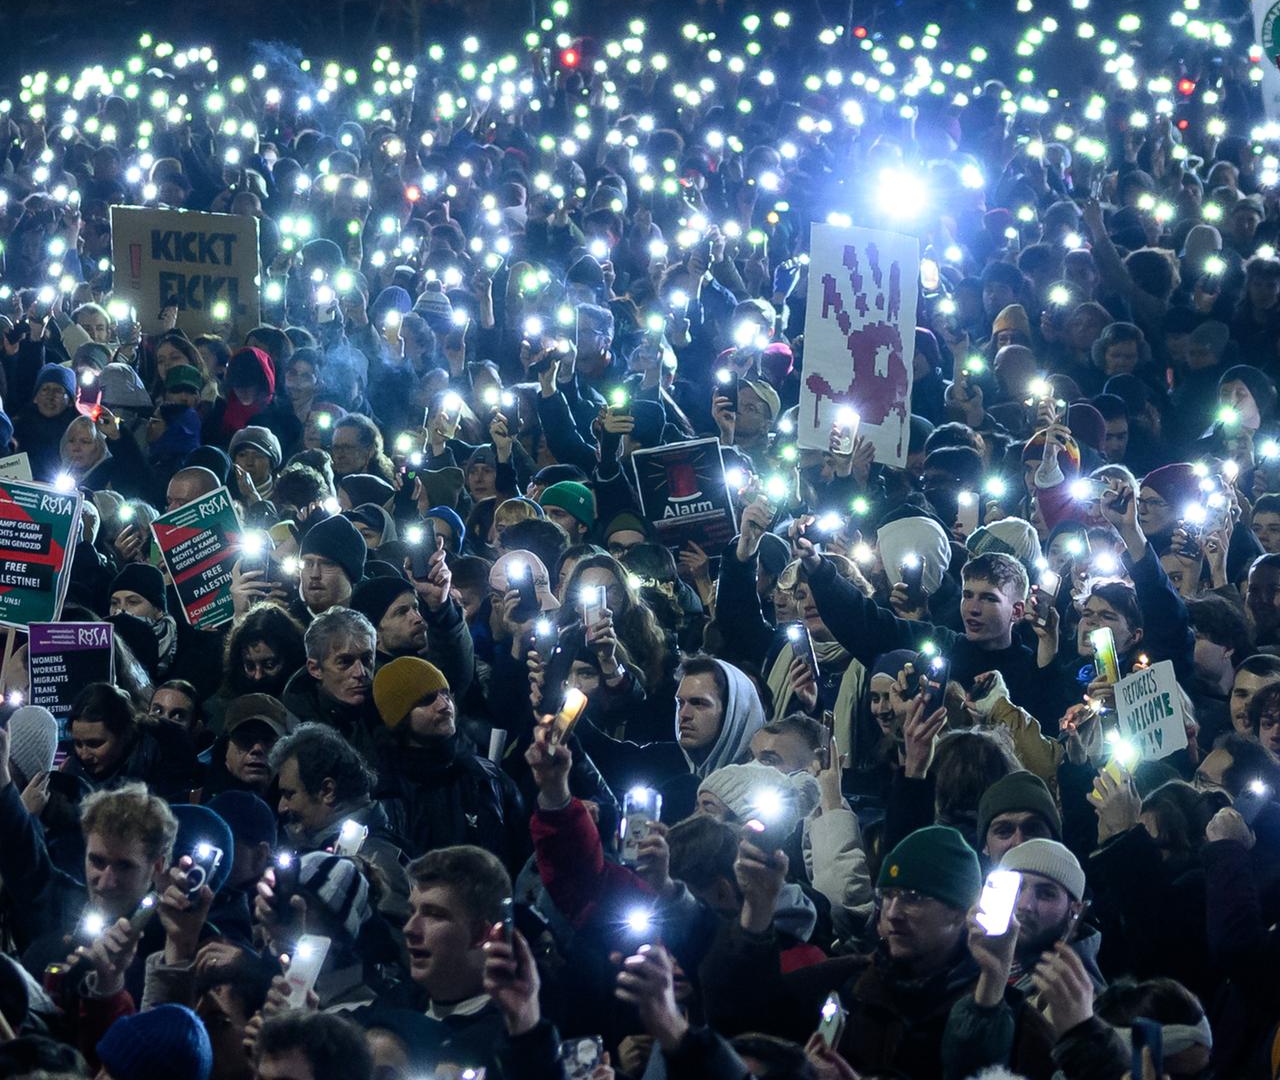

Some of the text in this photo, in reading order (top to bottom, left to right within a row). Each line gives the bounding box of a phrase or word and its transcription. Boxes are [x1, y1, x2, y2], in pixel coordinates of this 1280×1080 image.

[150, 229, 238, 265] KICKT
[663, 500, 713, 519] Alarm
[18, 522, 40, 531] GEGEN
[20, 531, 43, 541] KAMPF
[11, 540, 41, 550] GENOZID
[172, 529, 212, 554] KAMPF GEGEN
[171, 550, 194, 564] RECHTS
[198, 535, 218, 549] KAMPF
[5, 561, 27, 572] FREE
[175, 557, 195, 570] GEGEN
[201, 564, 223, 580] FREE
[193, 572, 232, 598] PALESTIN
[4, 596, 21, 606] UNS!
[190, 602, 216, 618] SCHREIB
[32, 655, 63, 664] WOMENS
[32, 665, 67, 674] WORKERS
[33, 675, 68, 684] MIGRANTS
[34, 686, 56, 694] TRANS
[34, 696, 59, 704] RIGHTS
